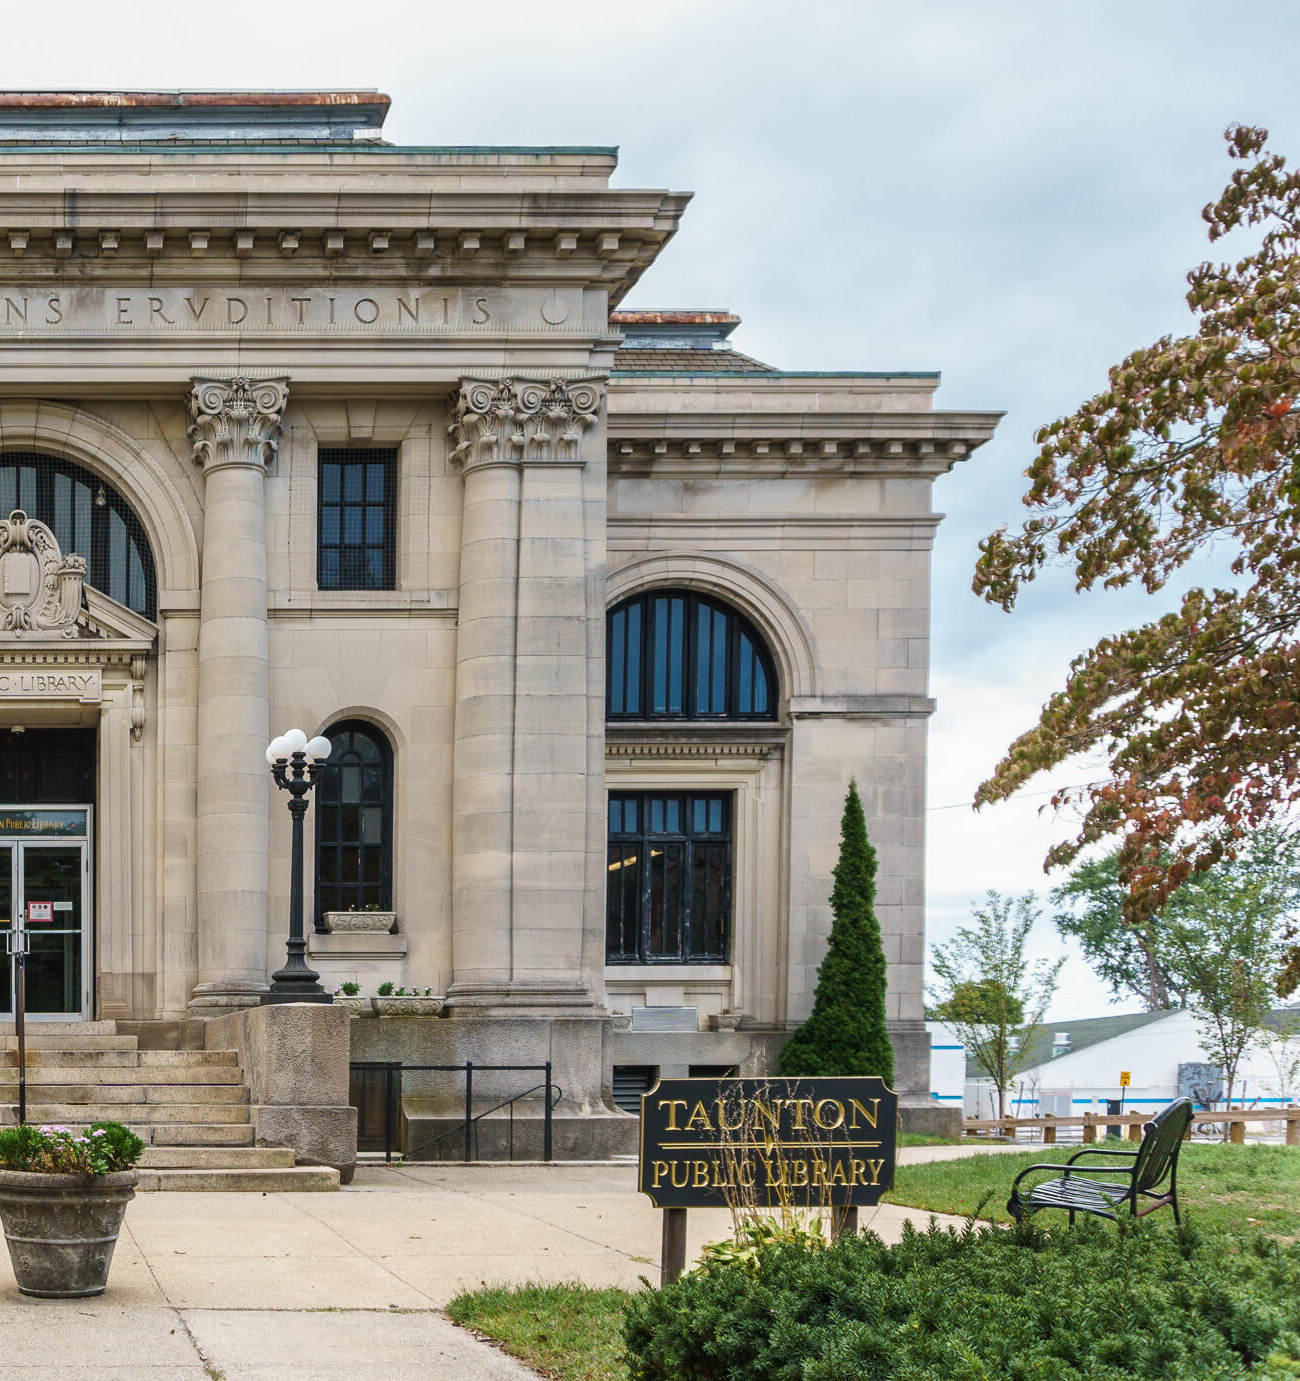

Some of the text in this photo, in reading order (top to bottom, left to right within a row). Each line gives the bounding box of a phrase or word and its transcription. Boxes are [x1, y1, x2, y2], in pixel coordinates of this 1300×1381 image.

[115, 297, 492, 325] ERVDITIONIS
[20, 675, 94, 692] LIBRARY
[657, 1098, 882, 1131] TAUNTON
[651, 1158, 885, 1188] PUBLIC LIBRARY
